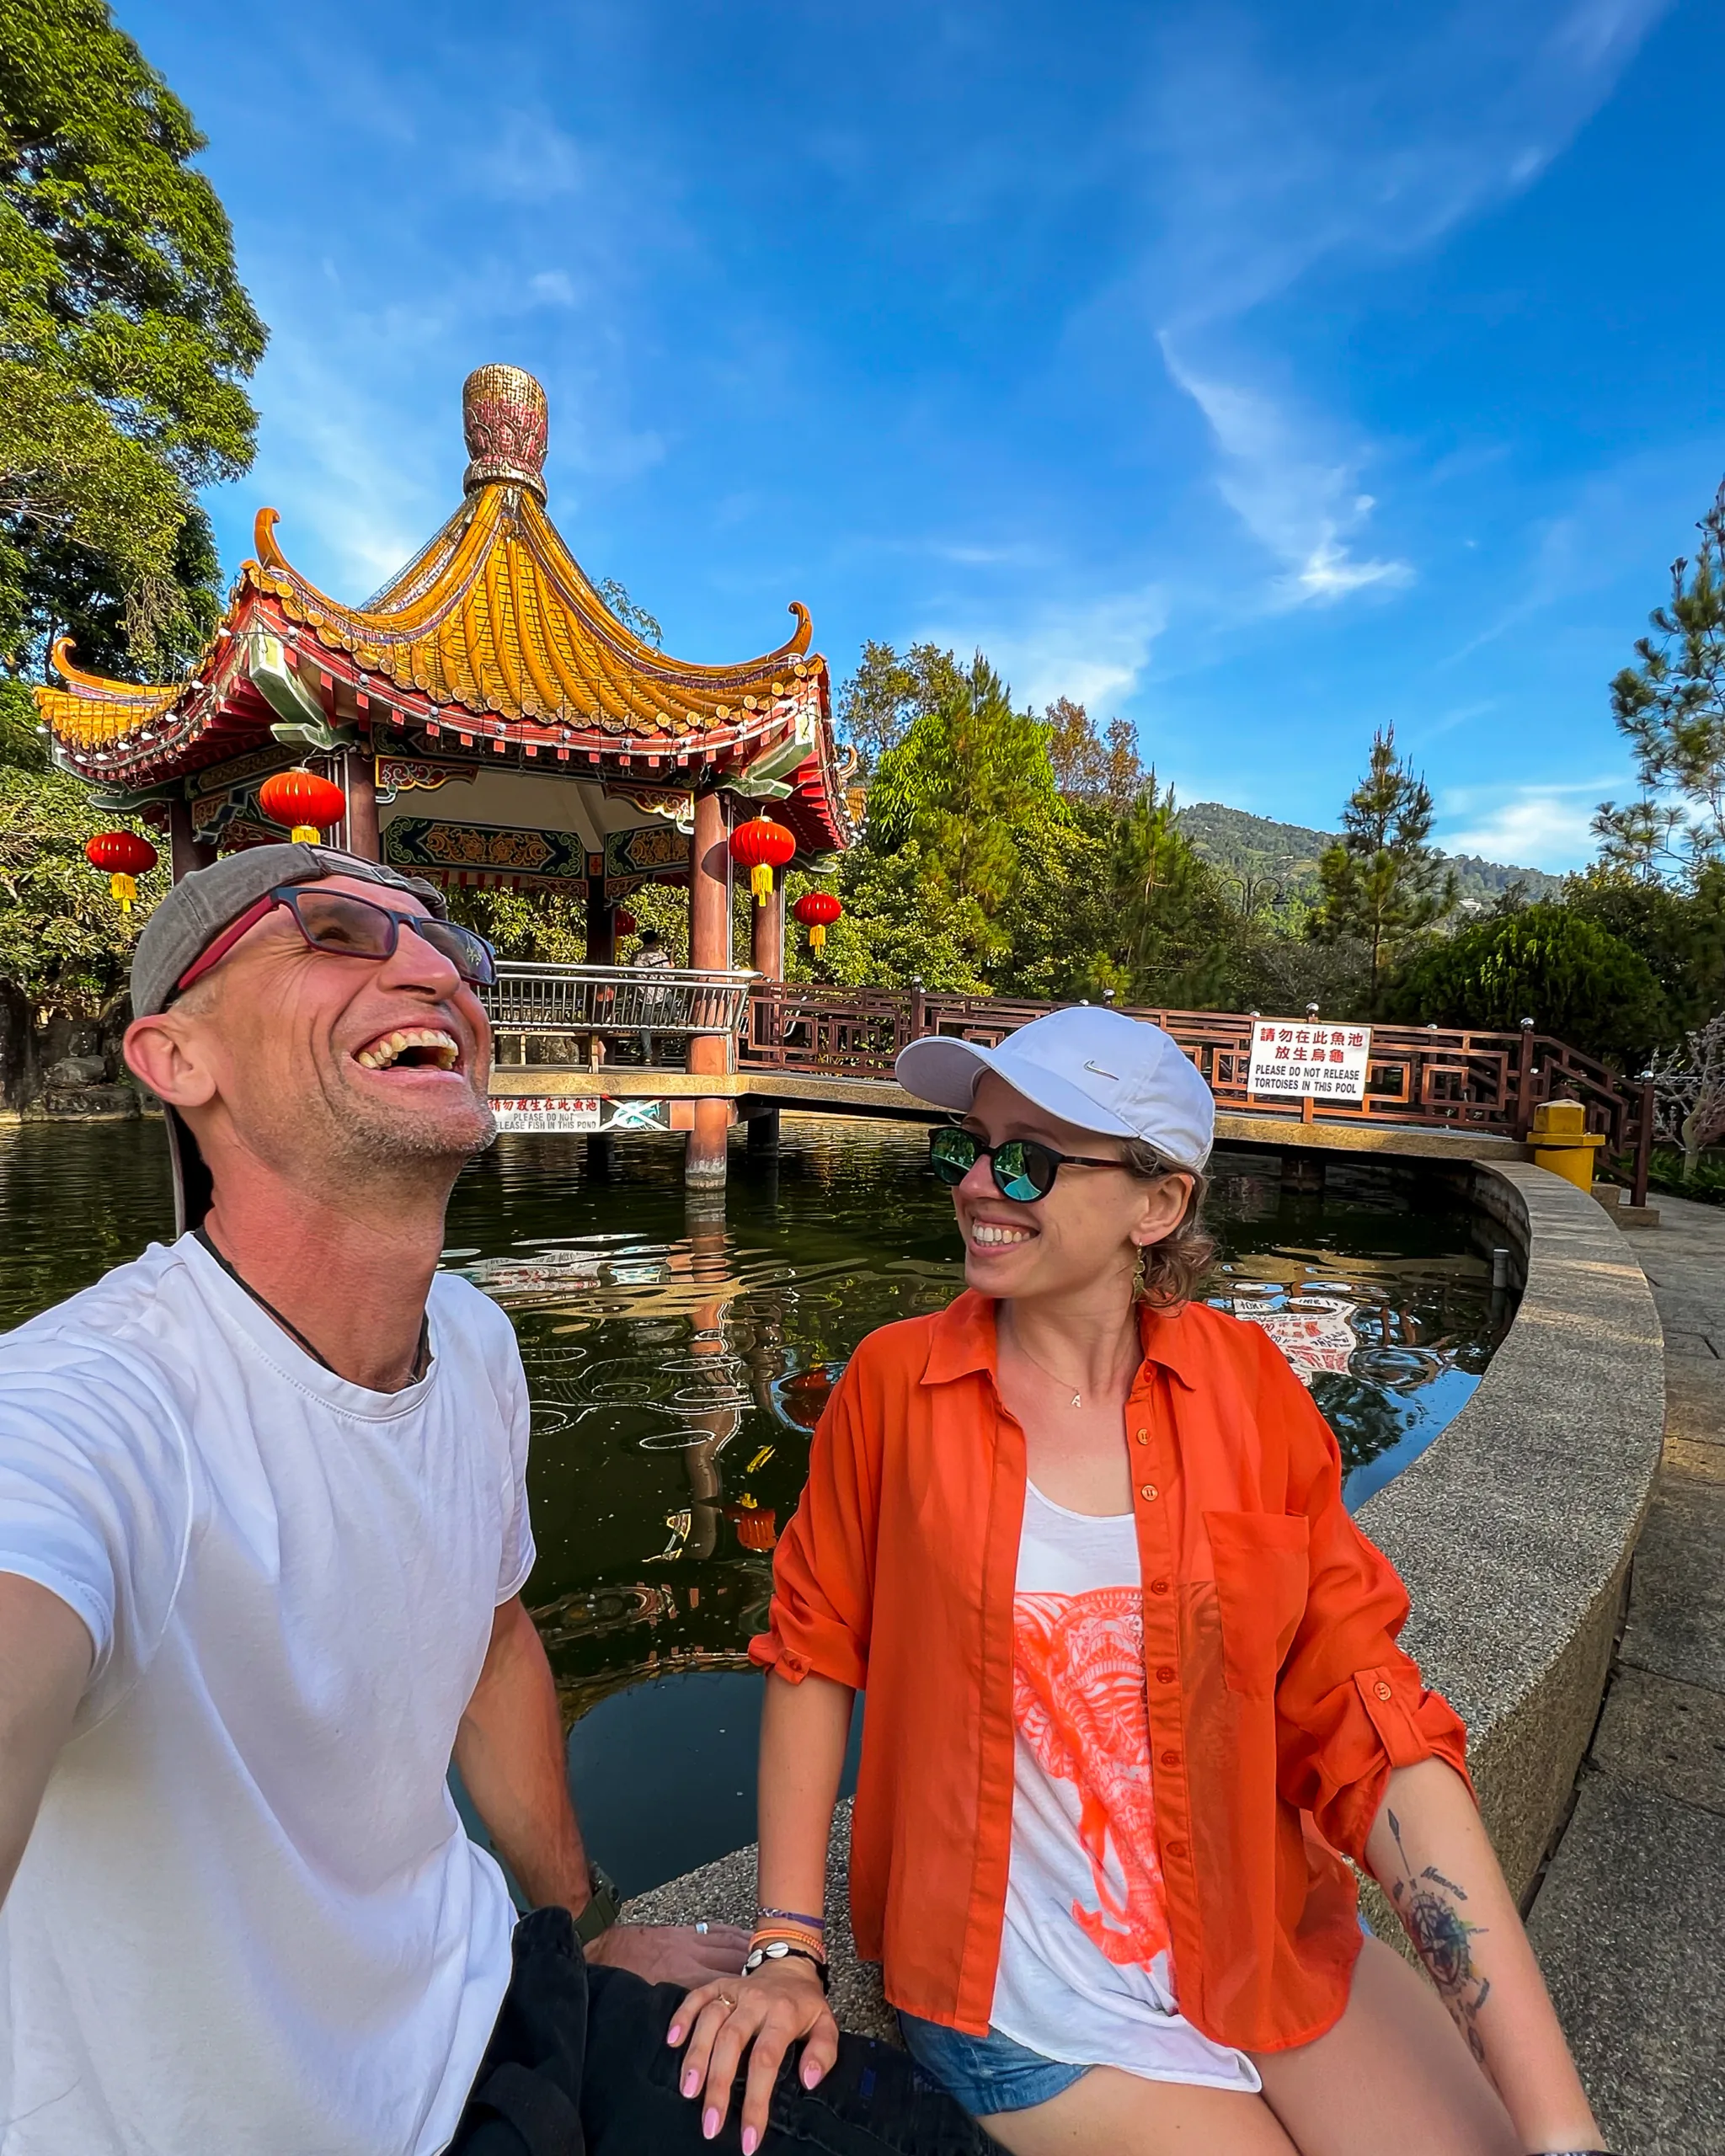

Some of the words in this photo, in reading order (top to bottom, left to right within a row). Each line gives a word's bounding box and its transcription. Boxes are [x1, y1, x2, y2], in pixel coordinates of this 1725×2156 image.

[1260, 1027, 1364, 1047] 請勿在此魚池
[1274, 1045, 1344, 1063] 放生烏龜
[1255, 1065, 1286, 1075] PLEASE
[1289, 1066, 1300, 1076] DO
[1303, 1067, 1321, 1077] NOT
[1323, 1068, 1359, 1080] RELEASE
[1255, 1078, 1299, 1090] TORTOISES
[1301, 1081, 1311, 1091] IN
[1314, 1081, 1332, 1091] THIS
[1335, 1083, 1356, 1093] POOL
[513, 1113, 543, 1121] PLEASE
[547, 1113, 556, 1121] DO
[559, 1113, 574, 1121] NOT
[528, 1121, 545, 1129] FISH
[547, 1121, 555, 1129] IN
[558, 1121, 574, 1129] THIS
[577, 1121, 596, 1129] POND
